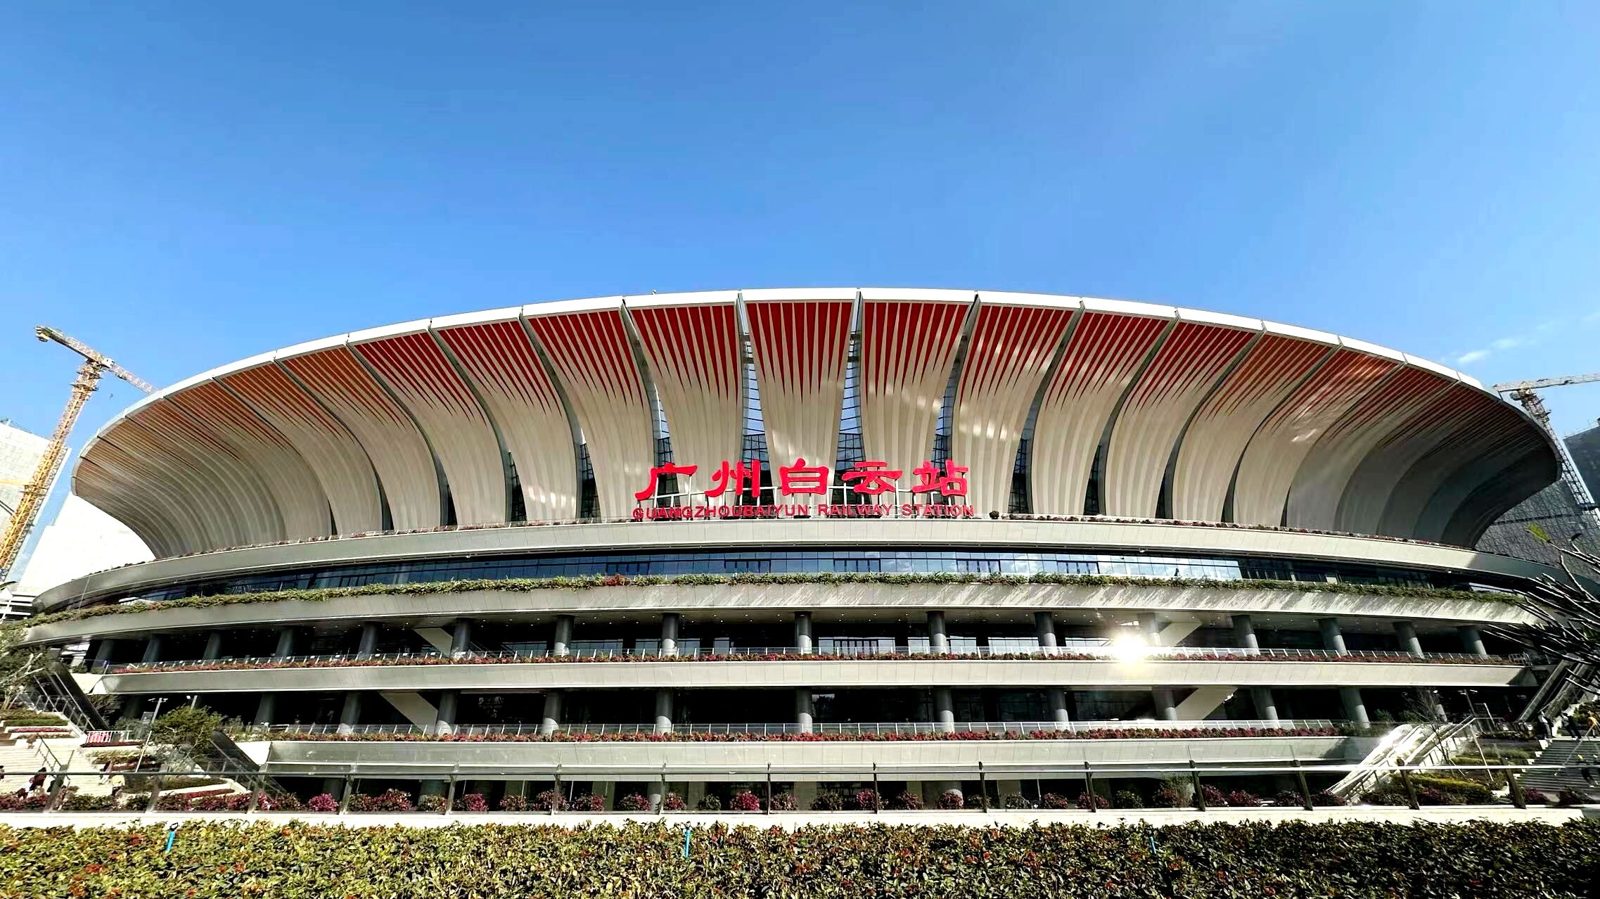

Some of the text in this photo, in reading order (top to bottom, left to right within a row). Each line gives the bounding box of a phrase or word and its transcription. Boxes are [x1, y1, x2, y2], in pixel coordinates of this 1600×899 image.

[635, 458, 969, 502] 广州白云站
[633, 504, 975, 519] GUANGZHOUBAIYUN RAILWAY STATION
